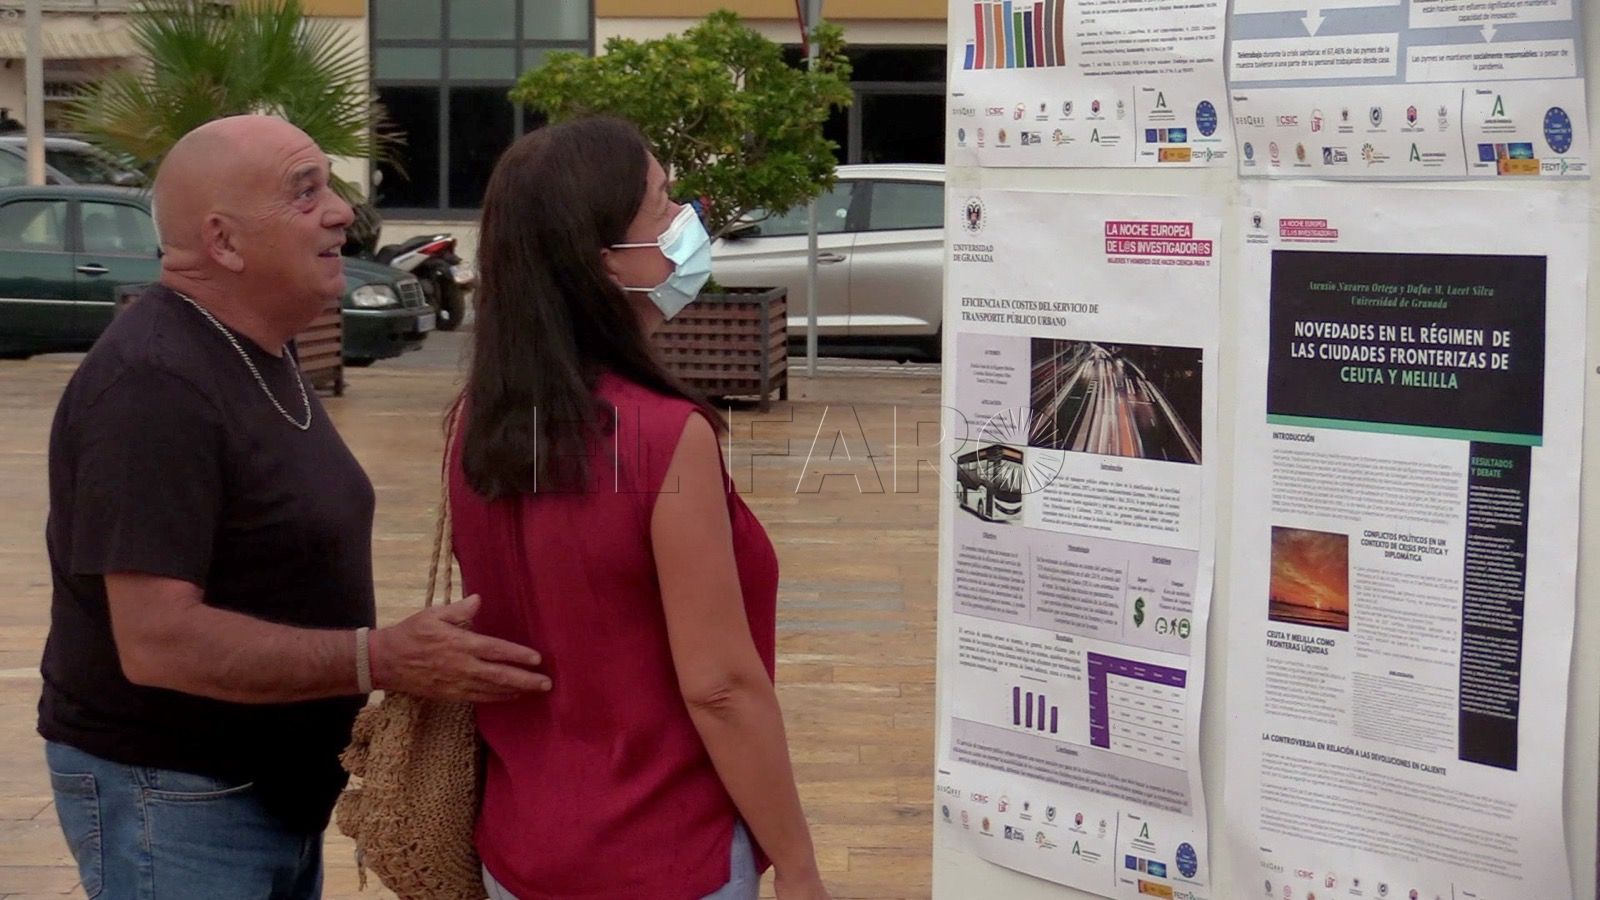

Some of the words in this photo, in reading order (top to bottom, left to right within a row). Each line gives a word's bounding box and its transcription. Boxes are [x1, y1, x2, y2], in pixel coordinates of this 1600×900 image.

[1106, 224, 1118, 236] LA
[1120, 224, 1149, 236] NOCHE
[1150, 225, 1191, 238] EUROPEA
[953, 244, 994, 253] UNIVERSIDAD
[1107, 241, 1117, 253] DE
[953, 254, 962, 262] DE
[962, 254, 994, 263] GRANADA
[1371, 283, 1398, 295] Ortega
[1472, 285, 1495, 297] Silva
[961, 297, 1001, 309] EFICIENCIA
[1001, 299, 1010, 309] EN
[1011, 300, 1037, 310] COSTES
[1038, 302, 1051, 311] DEL
[1052, 302, 1088, 313] SERVICIO
[1089, 304, 1100, 314] DE
[1351, 295, 1398, 308] Universidad
[1399, 297, 1409, 309] de
[1411, 298, 1448, 310] Granada
[961, 311, 1005, 324] TRANSPORTE
[1006, 311, 1036, 325] PÚBLICO
[1037, 315, 1067, 327] URBANO
[1294, 321, 1375, 341] NOVEDADES
[1379, 325, 1396, 342] EN
[1400, 327, 1415, 343] EL
[1420, 323, 1484, 346] RÉGIMEN
[1492, 331, 1511, 348] DE
[1291, 342, 1315, 359] LAS
[1319, 344, 1386, 364] CIUDADES
[1389, 348, 1487, 370] FRONTERIZAS
[1491, 353, 1509, 370] DE
[1341, 366, 1384, 385] CEUTA
[1387, 369, 1397, 385] Y
[1401, 370, 1458, 390] MELILLA
[1272, 432, 1315, 443] INTRODUCCIÓN
[1471, 457, 1513, 469] RESULTADOS
[1477, 469, 1502, 478] DEBATE
[1363, 530, 1398, 541] CONFLICTOS
[1398, 533, 1428, 545] POLÍTICOS
[1438, 539, 1446, 547] UN
[1361, 539, 1389, 549] CONTEXTO
[1390, 542, 1398, 551] DE
[1398, 543, 1417, 552] CRISIS
[1417, 545, 1443, 557] POLÍTICA
[1384, 551, 1423, 562] DIPLOMÁTICA
[1266, 630, 1285, 640] CEUTA
[1291, 634, 1315, 645] MELILLA
[1316, 637, 1335, 647] COMO
[1266, 640, 1300, 652] FRONTERAS
[1301, 642, 1329, 655] LÍQUIDAS
[1262, 732, 1270, 741] LA
[1270, 734, 1316, 750] CONTROVERSIA
[1317, 742, 1325, 751] EN
[1326, 743, 1355, 757] RELACIÓN
[1360, 750, 1371, 760] LAS
[1371, 752, 1411, 770] DEVOLUCIONES
[1412, 761, 1420, 770] EN
[1420, 763, 1447, 776] CALIENTE
